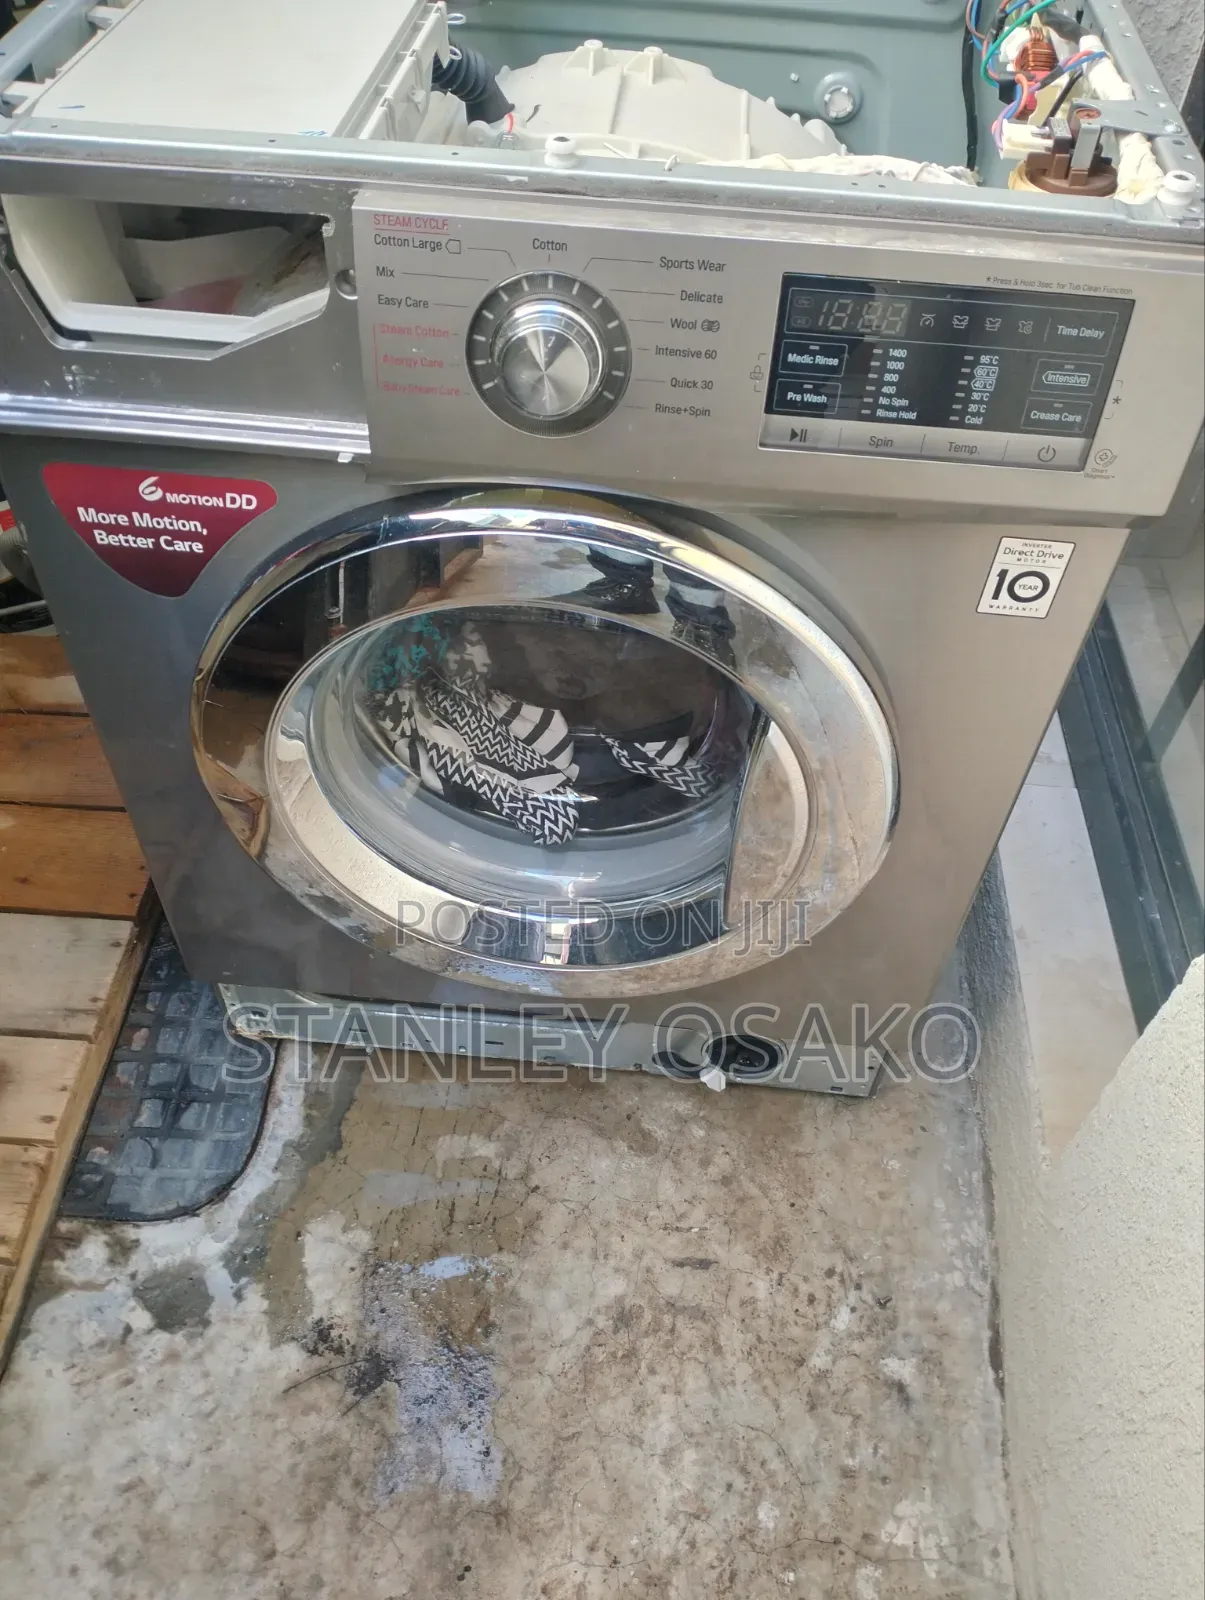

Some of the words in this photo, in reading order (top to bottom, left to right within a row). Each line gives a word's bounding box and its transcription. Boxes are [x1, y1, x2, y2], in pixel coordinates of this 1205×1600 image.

[373, 213, 412, 228] STEAM
[374, 233, 410, 248] Cotton
[412, 237, 443, 252] Large
[532, 237, 568, 251] Cotton
[659, 256, 695, 270] Sports
[697, 258, 727, 272] Wear
[376, 265, 395, 277] Mix
[377, 294, 402, 308] Easy
[405, 296, 429, 308] Care
[680, 290, 723, 304] Delicate
[670, 317, 697, 330] Wool
[381, 323, 412, 335] Steam
[415, 325, 449, 338] Cotton
[1057, 325, 1078, 336] Time
[1079, 327, 1105, 340] Delay
[655, 345, 702, 359] Intensive
[704, 349, 717, 360] 60
[888, 348, 907, 358] 1400
[420, 357, 444, 369] Care
[787, 353, 814, 364] Medic
[815, 355, 839, 366] Rinse
[886, 361, 905, 370] 1000
[670, 377, 698, 389] Quick
[701, 380, 714, 390] 30
[883, 373, 899, 382] 800
[1047, 373, 1087, 384] Intensive
[439, 386, 461, 396] Care
[881, 385, 897, 395] 400
[787, 391, 802, 402] Pre
[803, 393, 828, 404] Wash
[878, 396, 890, 405] No
[891, 398, 909, 407] Spin
[655, 403, 711, 418] Rinse+Spin
[876, 408, 898, 418] Rinse
[898, 410, 917, 420] Hold
[1030, 410, 1061, 421] Crease
[1061, 412, 1082, 422] Care
[964, 415, 983, 425] Cold
[868, 435, 894, 448] Spin
[947, 441, 980, 455] Temp.
[77, 507, 130, 526] More
[131, 511, 208, 535] Motion,
[93, 529, 155, 549] Better
[159, 535, 204, 553] Care
[1003, 547, 1034, 557] Direct
[1036, 549, 1065, 560] Drive
[991, 568, 1050, 603] 10
[1017, 583, 1039, 591] YEAR
[988, 603, 1039, 613] WARRANTY
